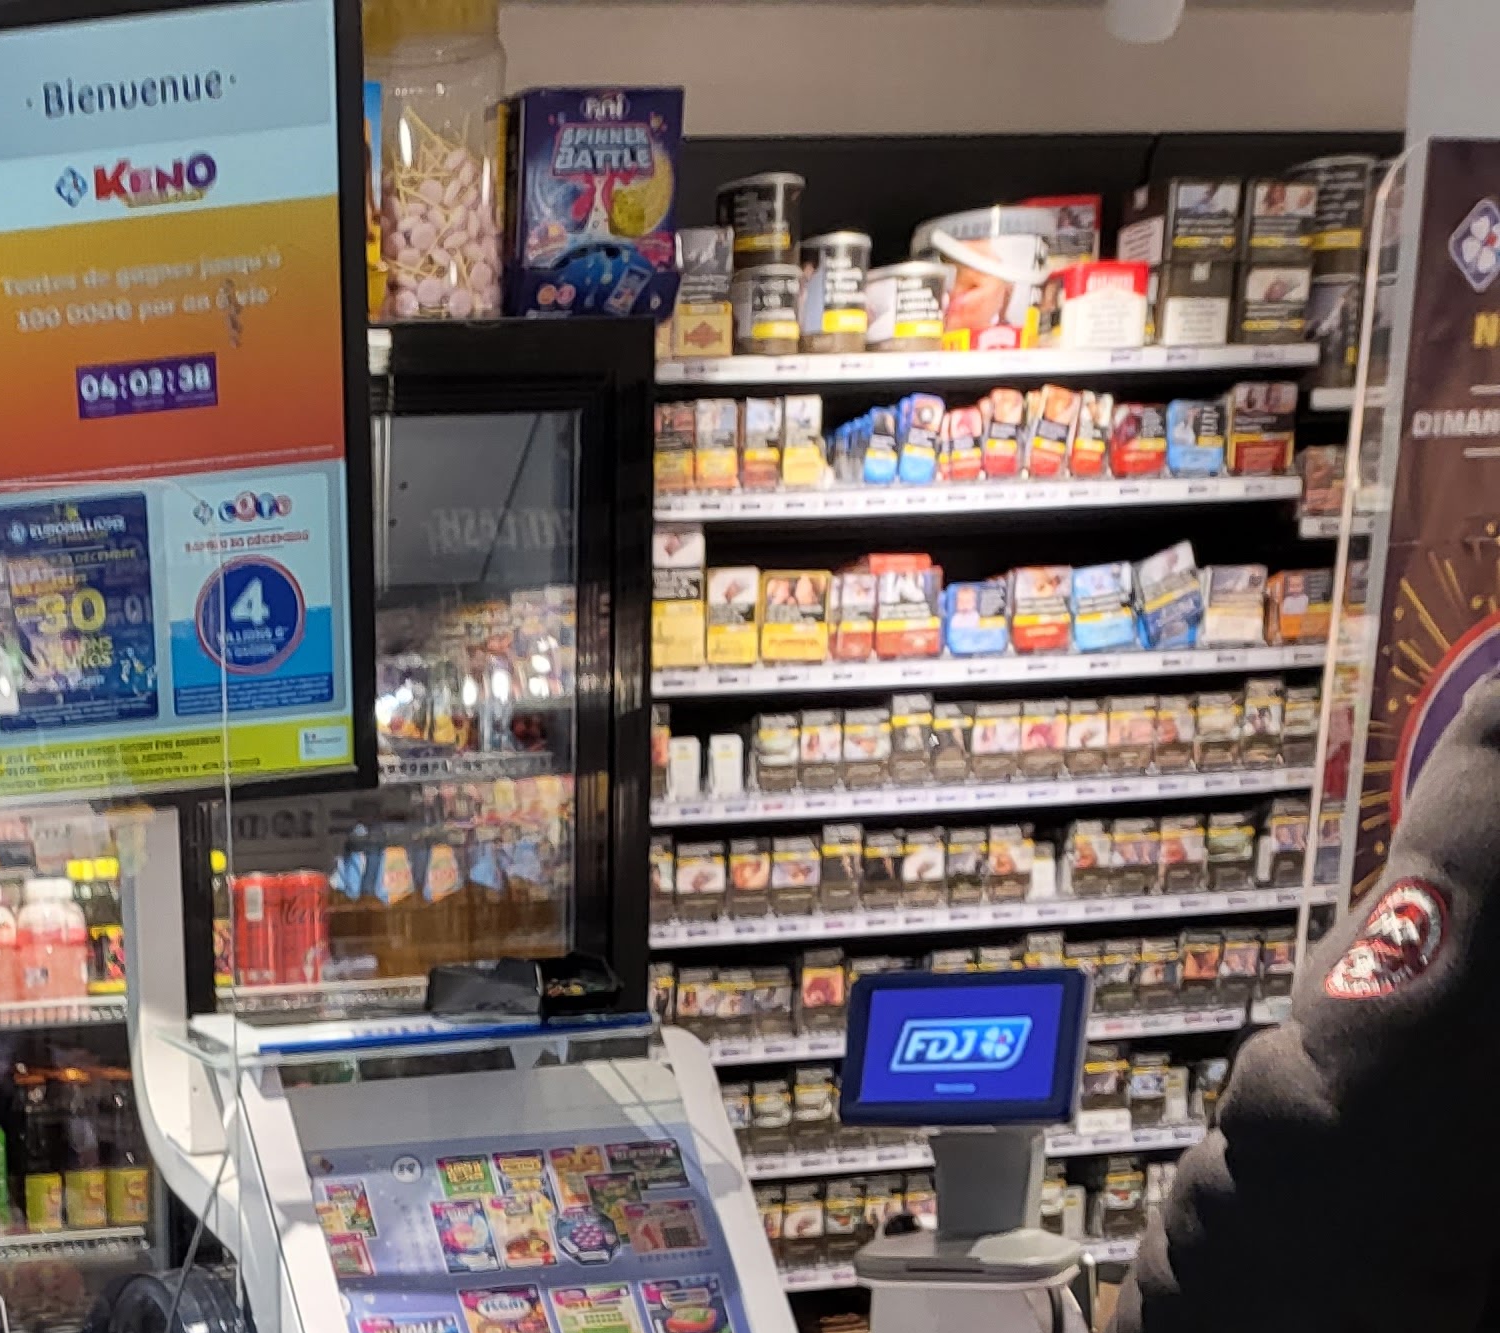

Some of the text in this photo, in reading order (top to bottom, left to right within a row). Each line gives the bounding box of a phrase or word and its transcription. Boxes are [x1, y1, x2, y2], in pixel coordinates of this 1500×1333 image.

[42, 70, 223, 119] Bienvenue
[561, 127, 649, 147] SPINNER
[94, 151, 218, 201] KENO
[555, 146, 650, 170] BATTLE
[229, 577, 271, 626] 4
[904, 1029, 978, 1062] FDJ
